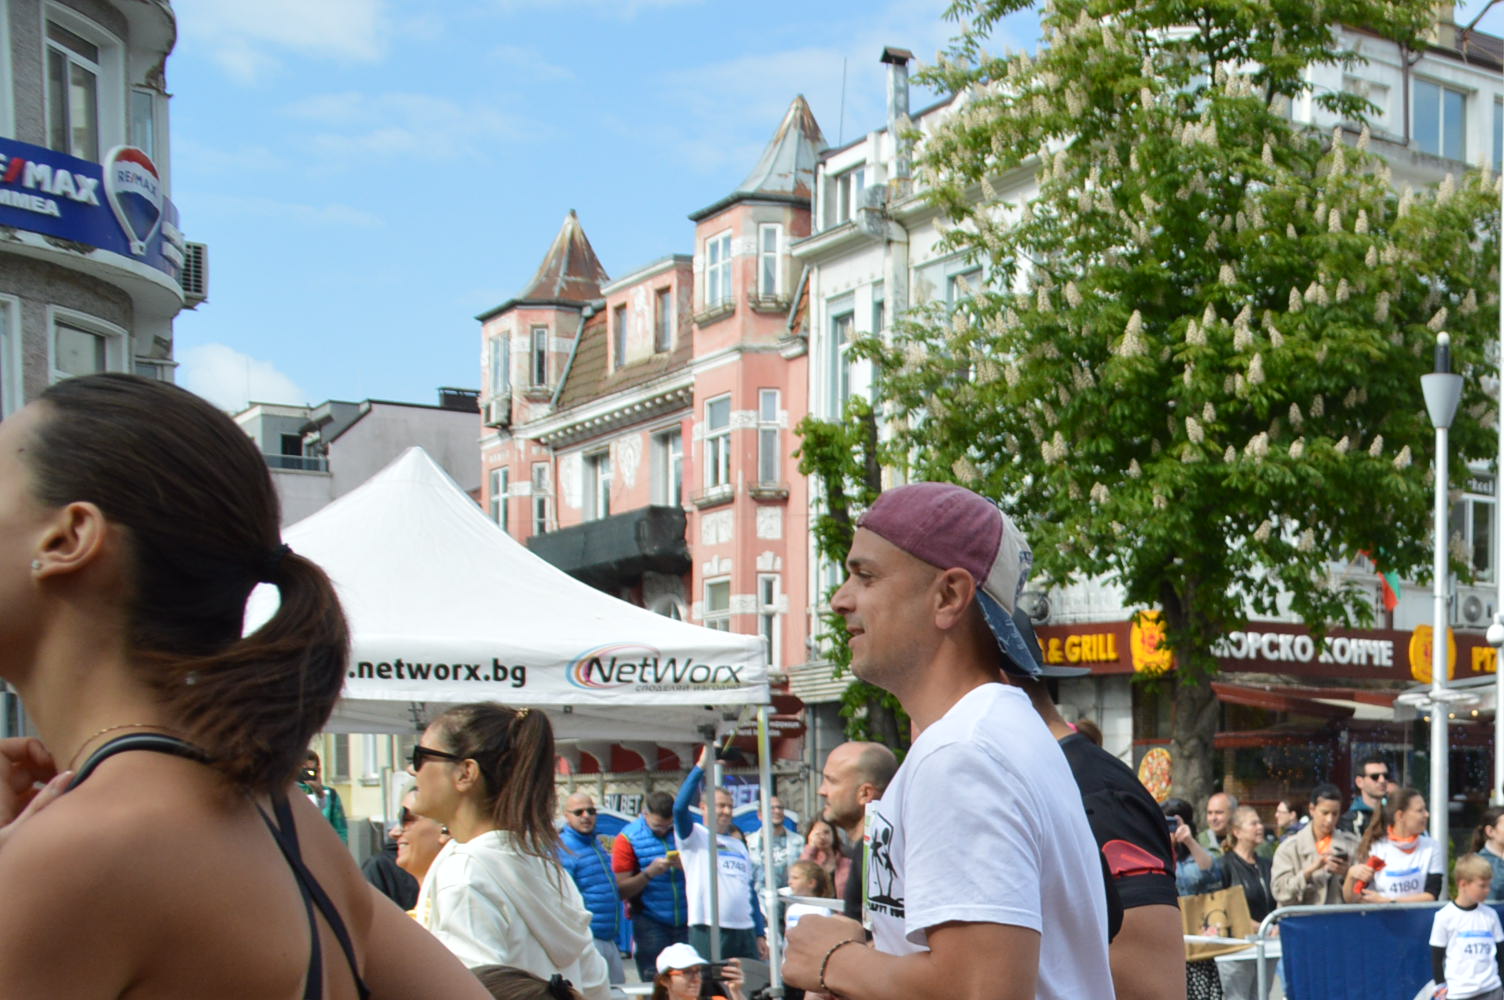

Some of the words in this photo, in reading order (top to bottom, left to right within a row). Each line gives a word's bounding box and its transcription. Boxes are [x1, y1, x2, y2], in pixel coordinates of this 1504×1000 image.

[118, 170, 156, 194] RE/MAX
[1064, 633, 1119, 664] GRILL
[585, 656, 744, 684] NetWorx
[1389, 878, 1420, 893] 4180
[1464, 942, 1492, 955] 4179
